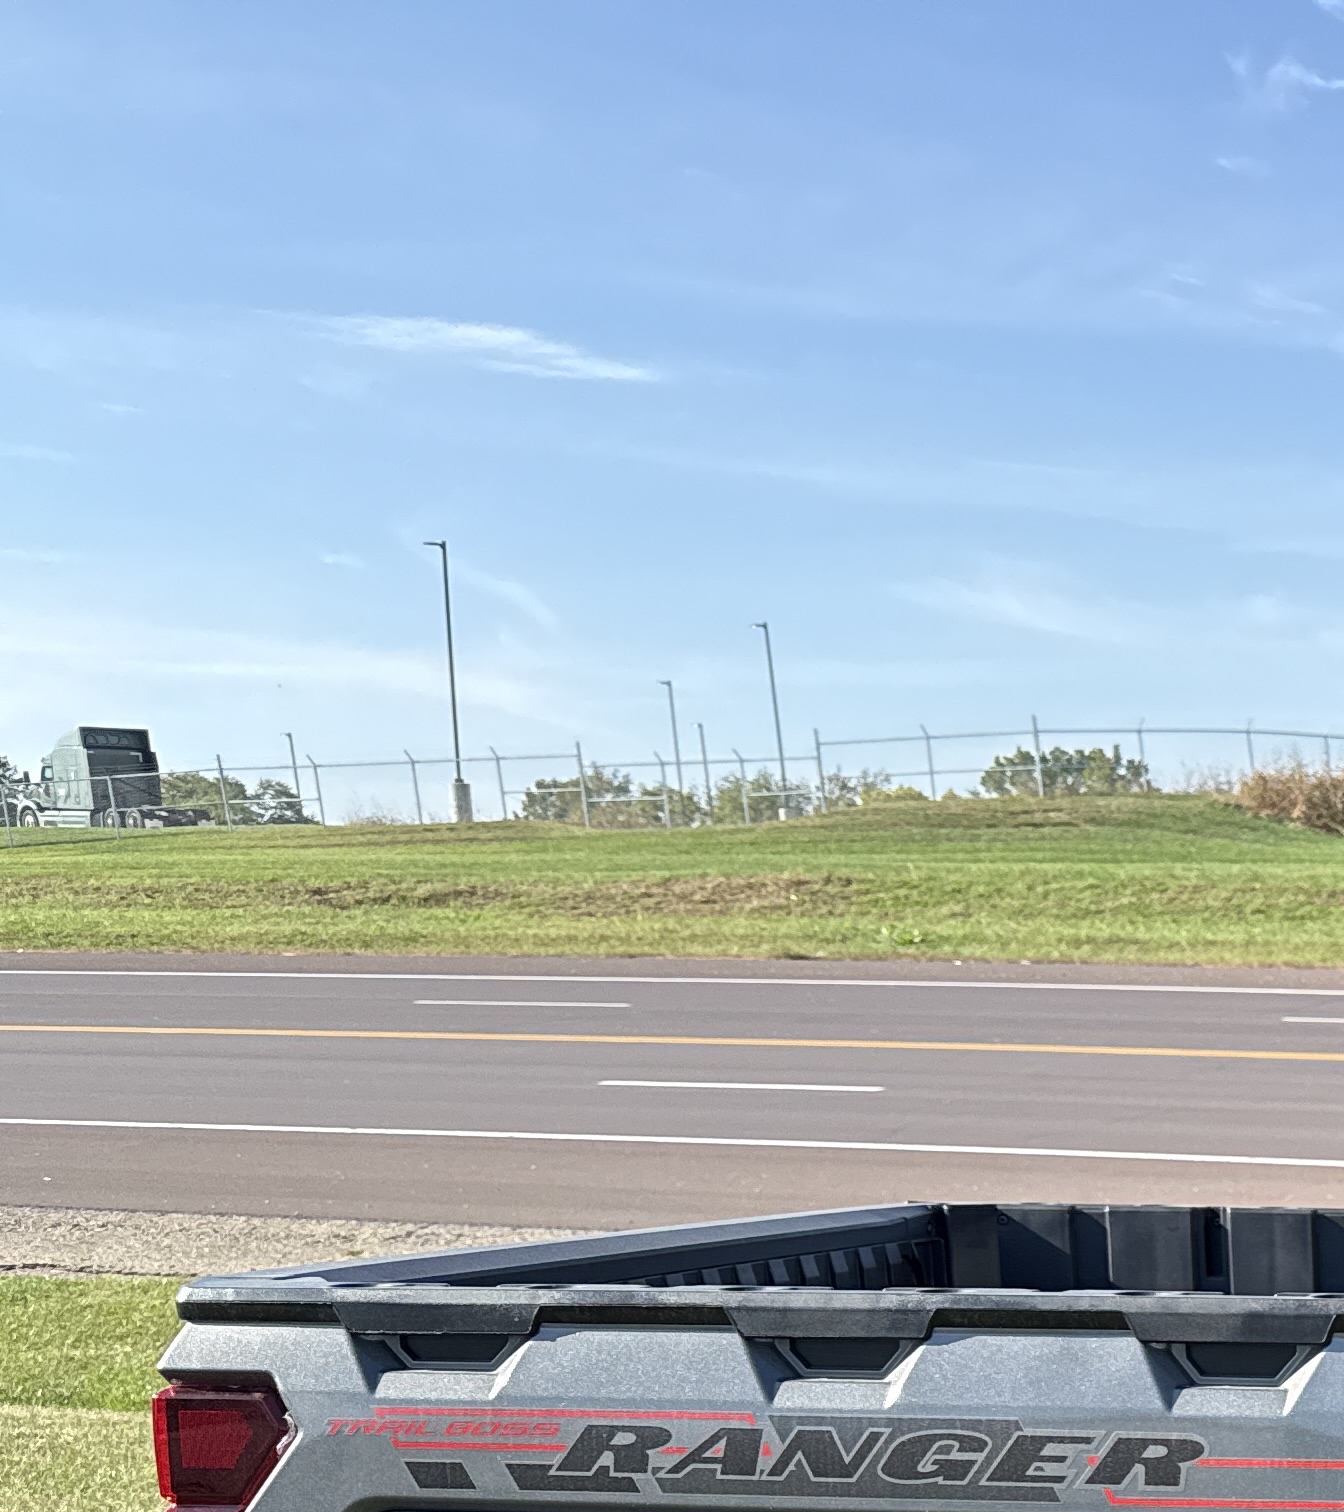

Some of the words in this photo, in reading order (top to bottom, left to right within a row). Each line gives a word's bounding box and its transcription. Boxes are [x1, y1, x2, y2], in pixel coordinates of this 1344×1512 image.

[325, 1418, 435, 1436] TRAIL
[443, 1421, 561, 1437] BOSS
[548, 1424, 1209, 1490] RANGER
